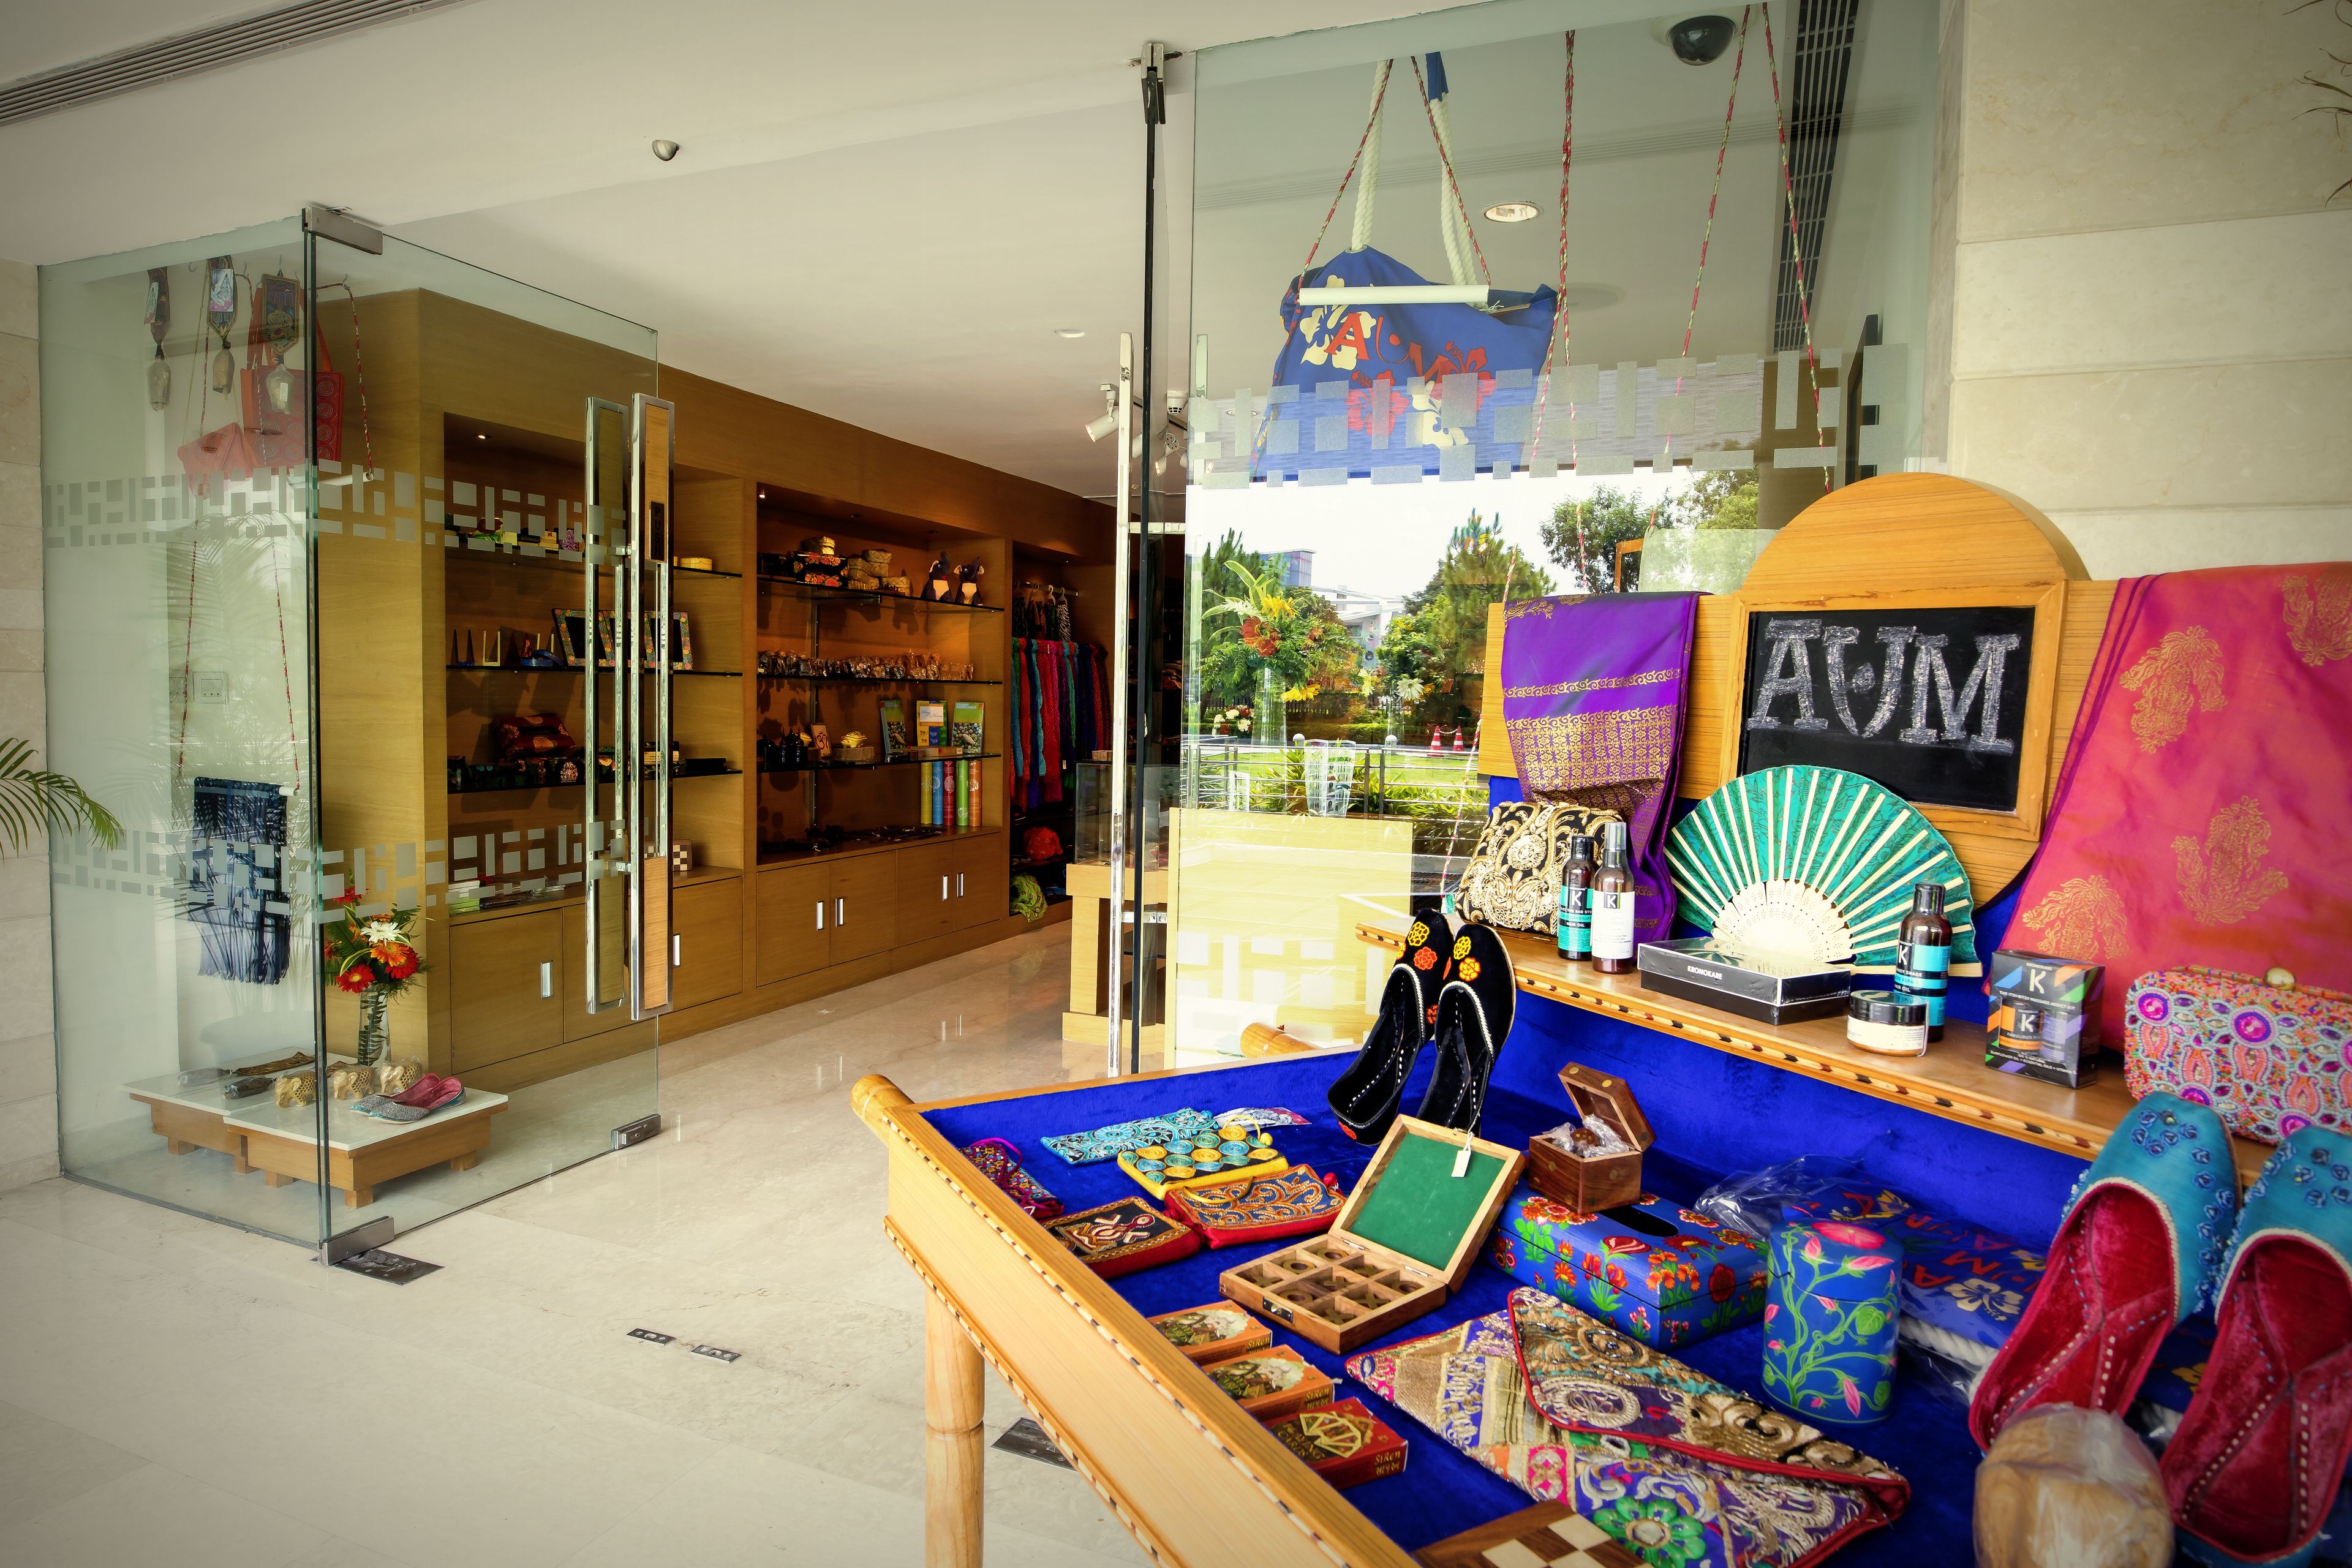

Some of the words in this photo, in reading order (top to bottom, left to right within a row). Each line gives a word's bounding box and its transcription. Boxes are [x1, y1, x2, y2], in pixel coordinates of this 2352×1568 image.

[1746, 618, 2021, 755] AUM
[1572, 890, 1582, 907] K
[1607, 894, 1616, 908] K
[1898, 944, 1909, 965] K
[1687, 965, 1724, 980] KRONOKARE
[2029, 968, 2047, 994] K
[2021, 1014, 2035, 1033] K
